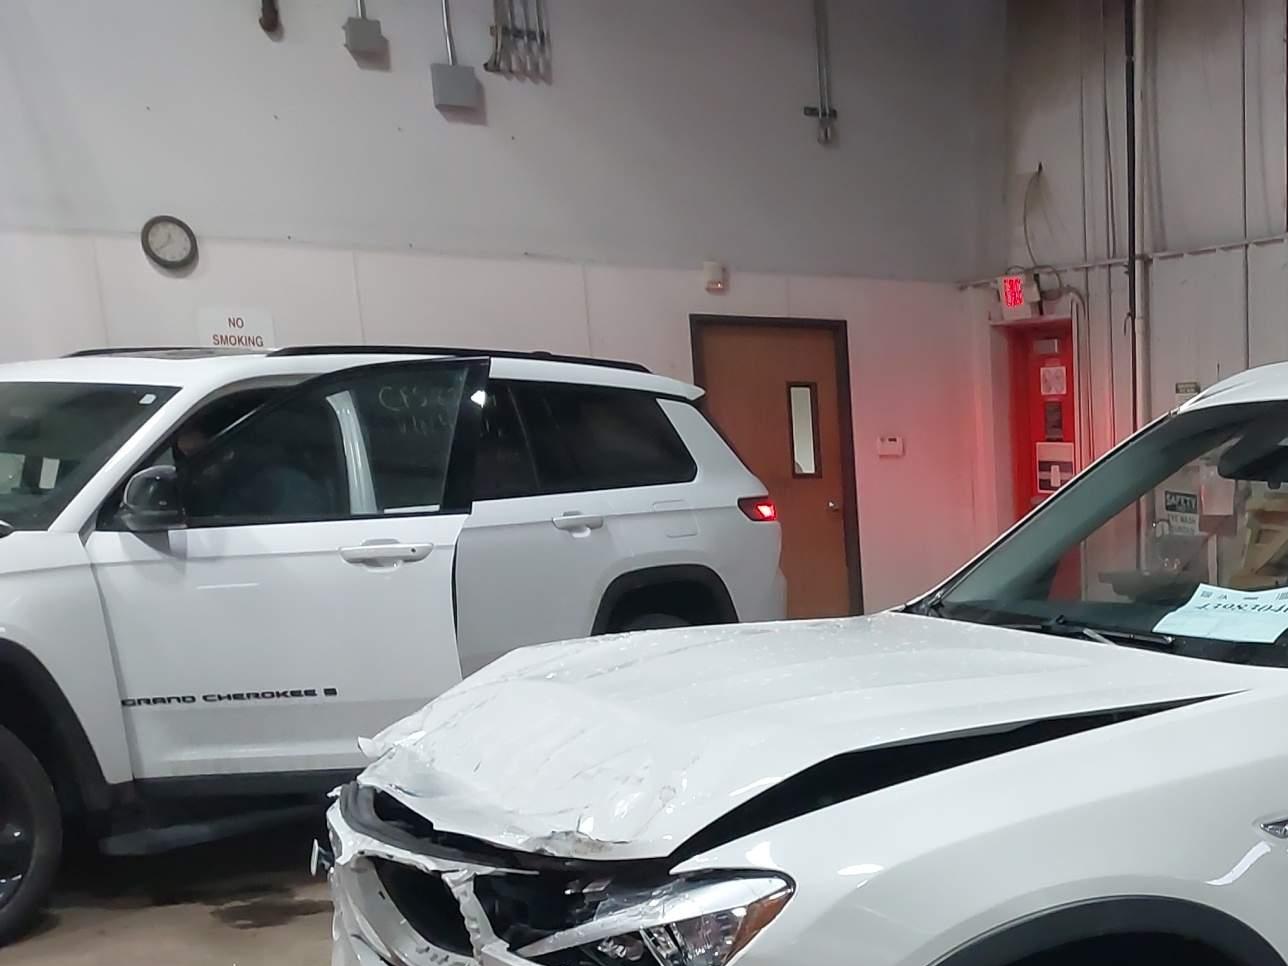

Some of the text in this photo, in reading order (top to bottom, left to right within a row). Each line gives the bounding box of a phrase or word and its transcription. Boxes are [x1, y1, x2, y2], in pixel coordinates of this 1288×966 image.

[227, 316, 245, 329] NO
[212, 334, 264, 348] SMOKING
[121, 695, 197, 707] GRAND
[202, 689, 318, 702] CHEROKEE
